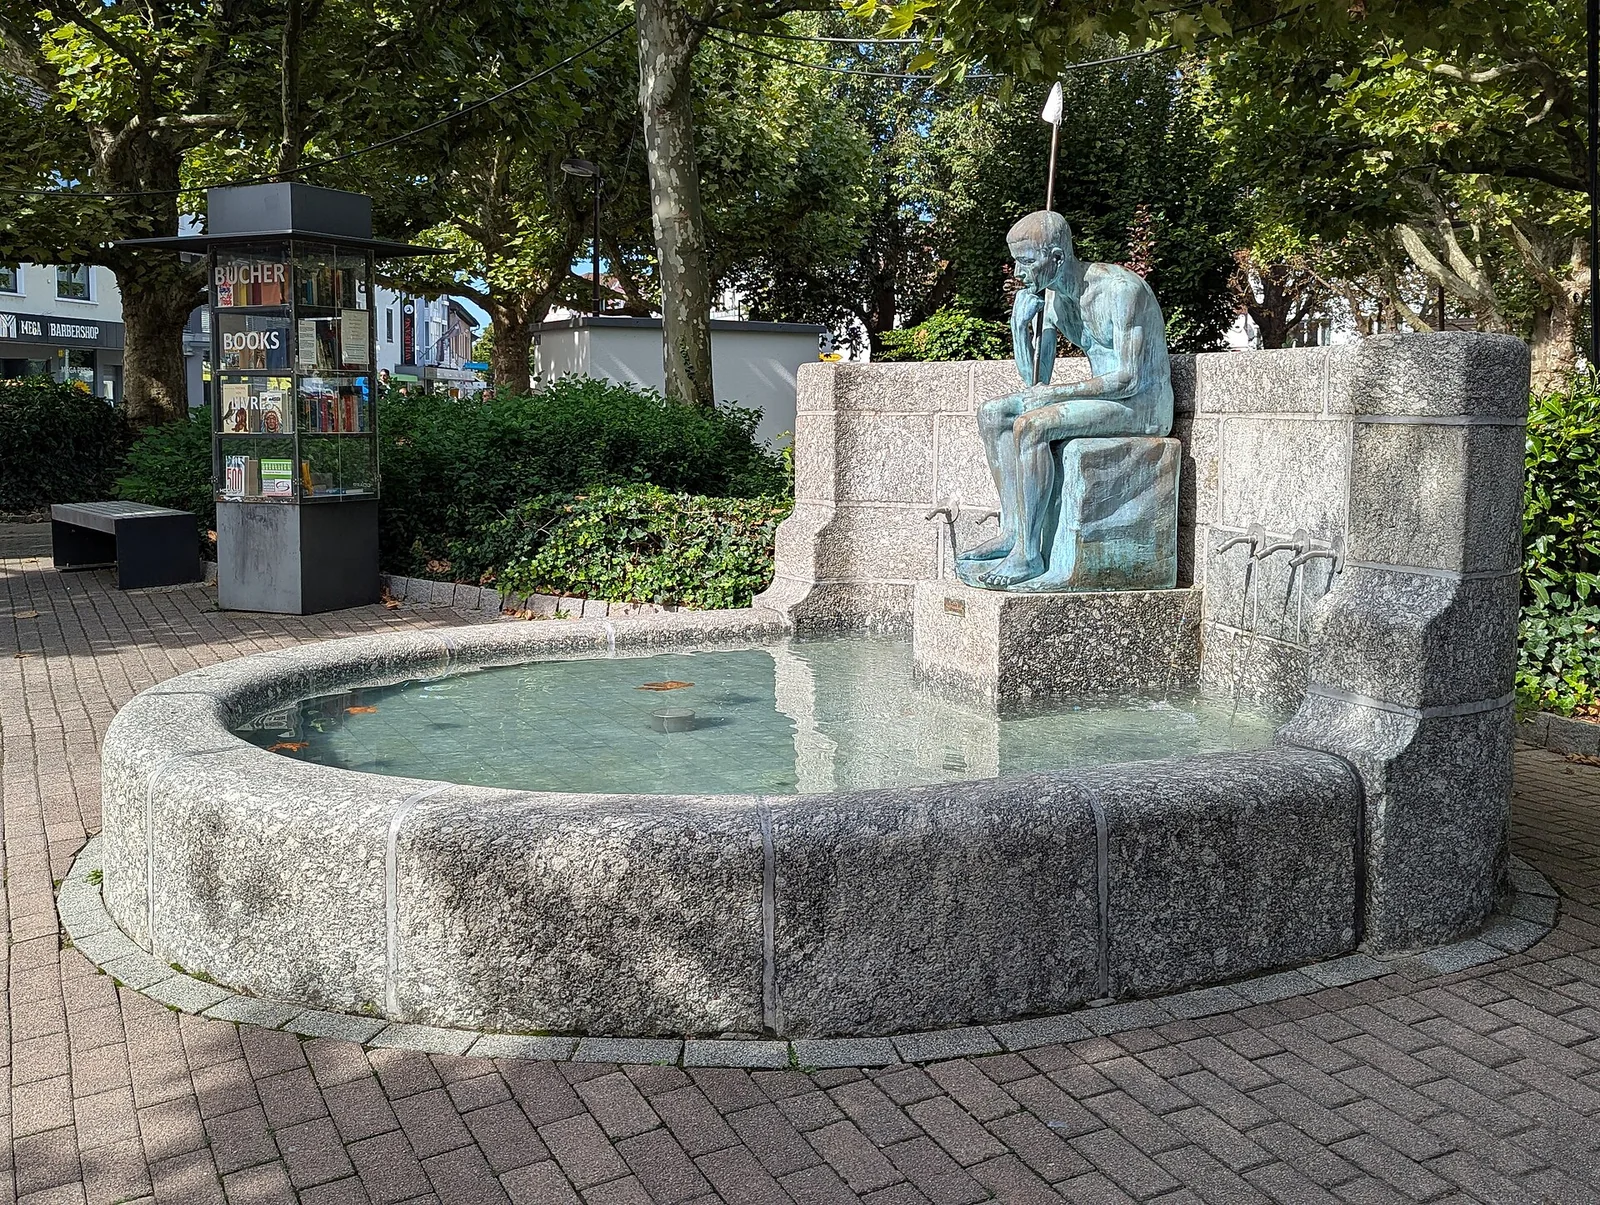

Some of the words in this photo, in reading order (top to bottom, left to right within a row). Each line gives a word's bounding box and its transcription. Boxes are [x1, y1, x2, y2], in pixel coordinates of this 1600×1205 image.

[214, 261, 285, 286] BÜCHER
[21, 320, 42, 336] MEGA
[50, 322, 99, 339] BARBERSHOP
[223, 331, 280, 350] BOOKS
[230, 395, 274, 410] LIVRES
